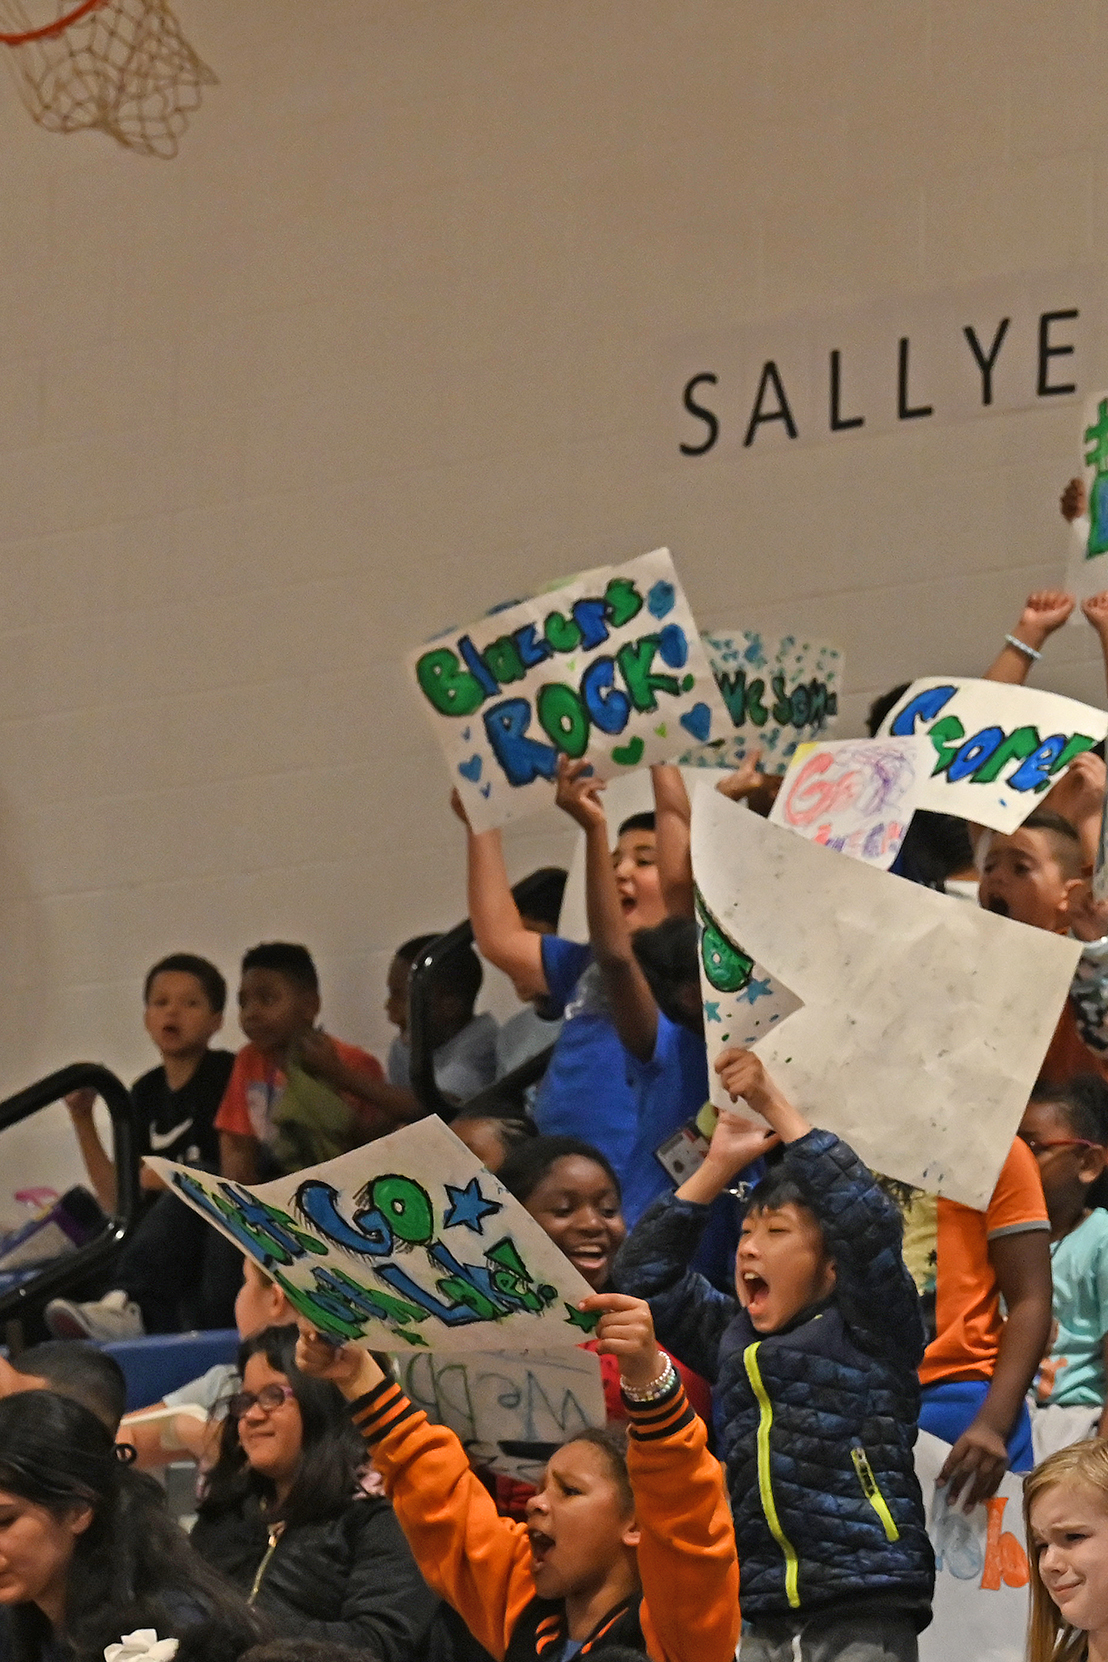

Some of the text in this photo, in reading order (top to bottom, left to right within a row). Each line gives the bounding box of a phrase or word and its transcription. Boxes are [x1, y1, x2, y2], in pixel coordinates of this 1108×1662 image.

[678, 307, 1081, 457] SALLYE
[415, 577, 644, 718] Blazers
[297, 1173, 436, 1258] GO
